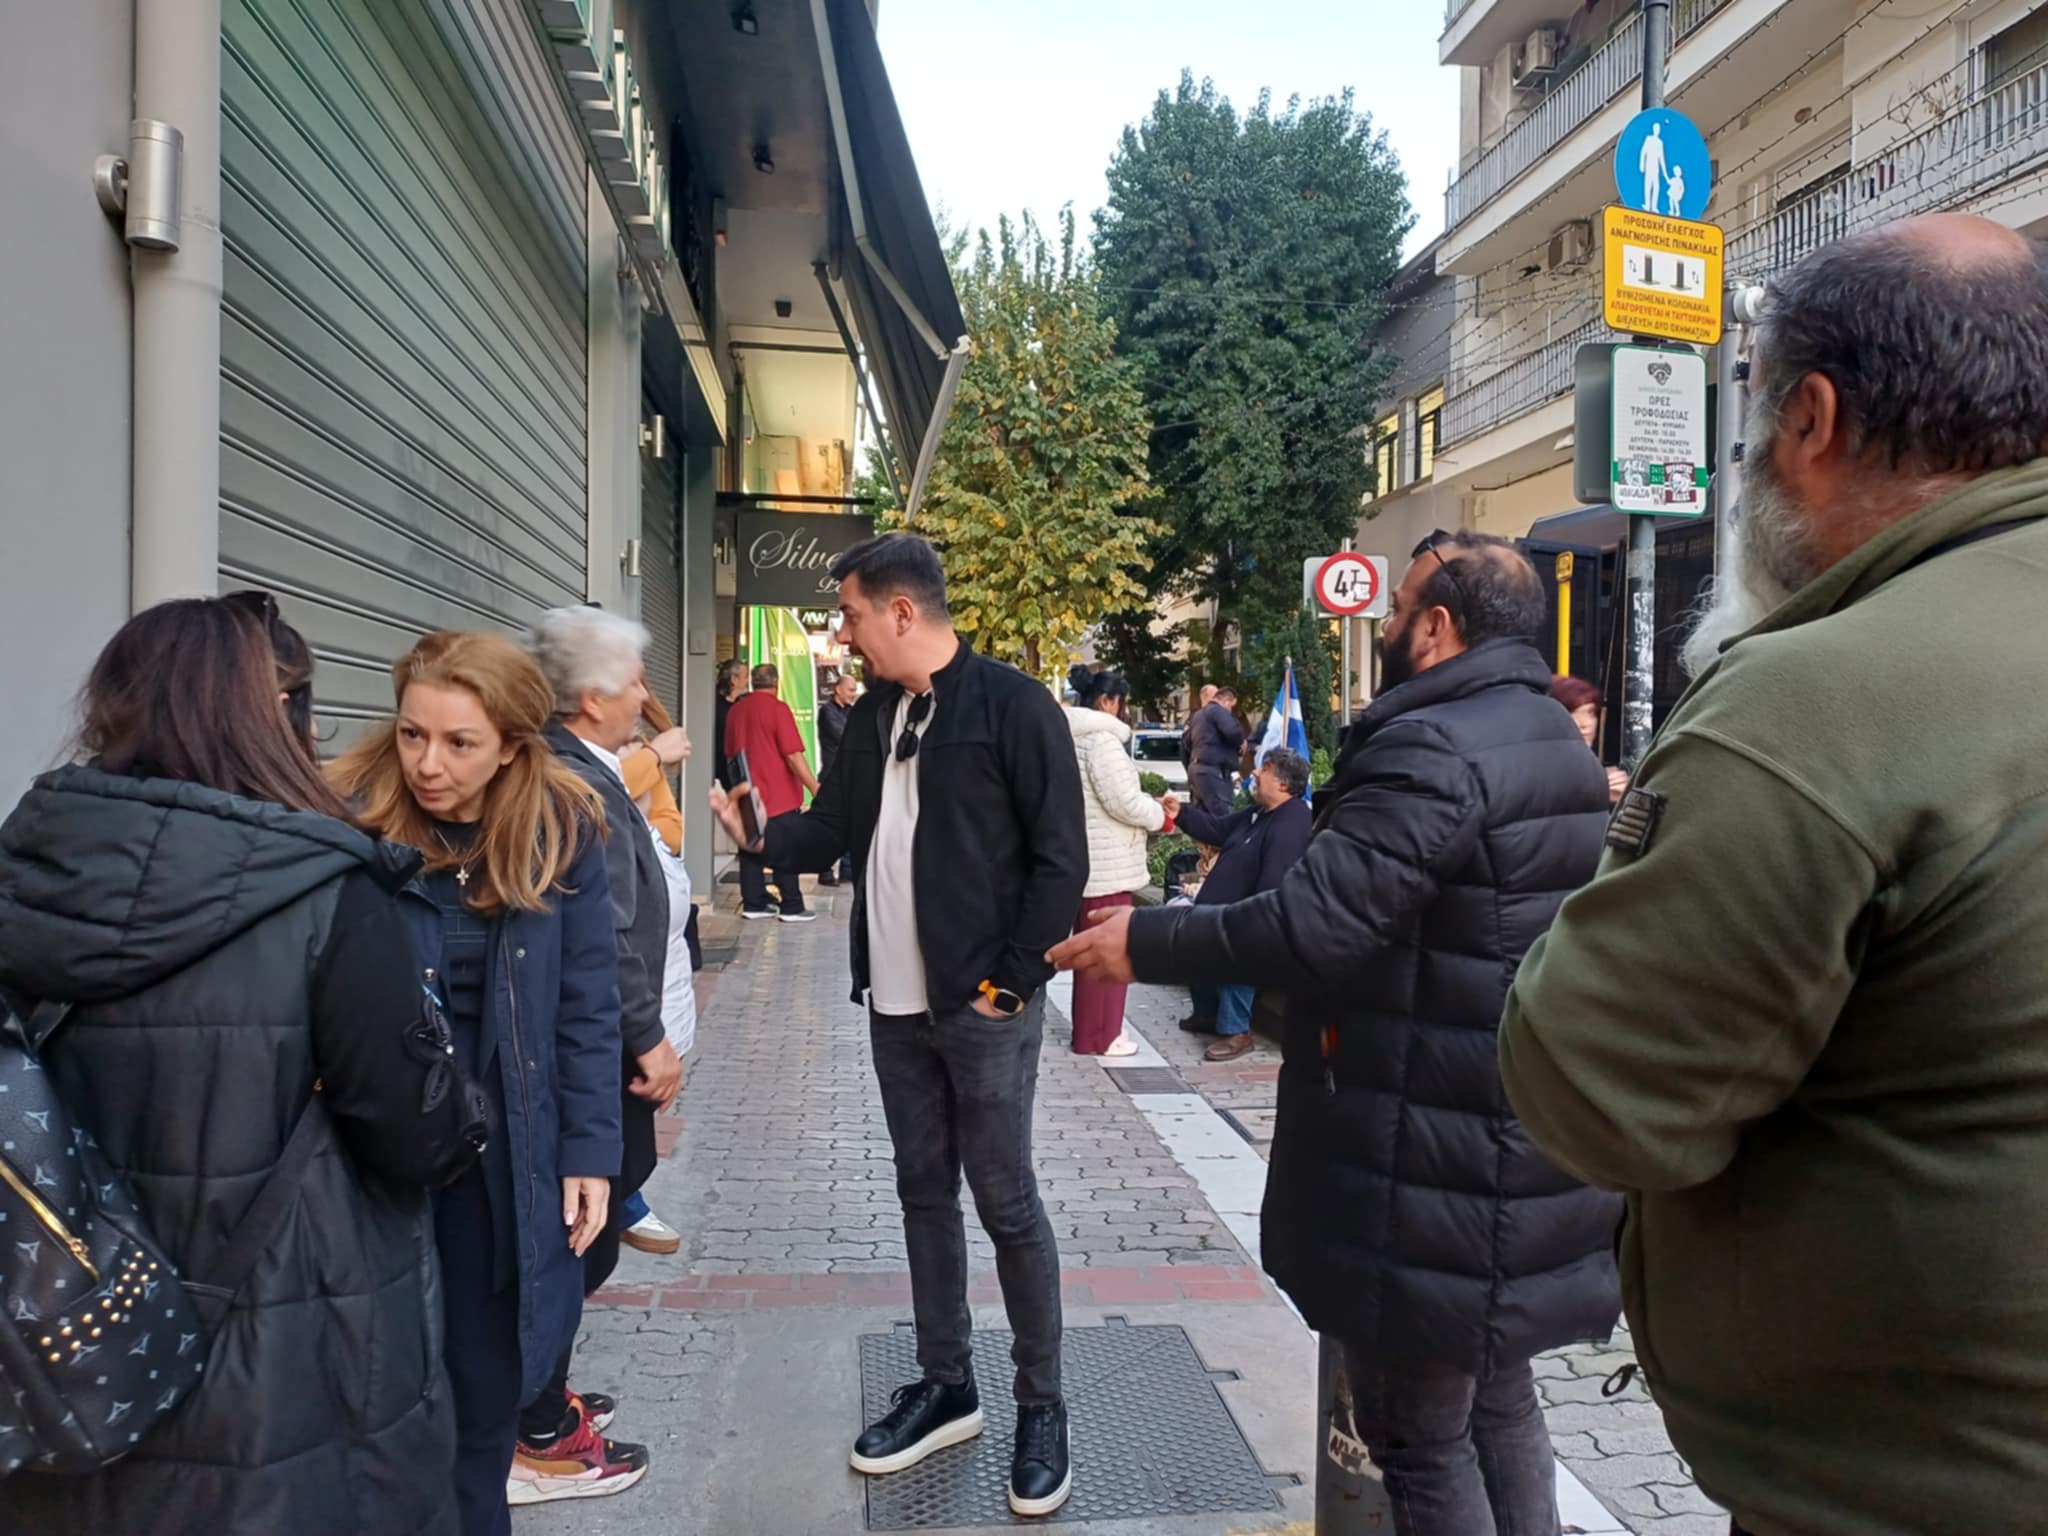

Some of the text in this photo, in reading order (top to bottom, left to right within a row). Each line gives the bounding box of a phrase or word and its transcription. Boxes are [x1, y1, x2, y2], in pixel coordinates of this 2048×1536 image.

[1623, 215, 1705, 239] ΠΡΟΣΟΧΗ ΕΛΕΓΧΟΣ
[1672, 238, 1718, 256] ΠΙΝΑΚΙΔΑΣ
[1649, 395, 1671, 407] ΩΡΕΣ
[1631, 406, 1688, 421] ΤΡΟΦΟΔΟΣΙΑΣ
[749, 527, 843, 577] Silve
